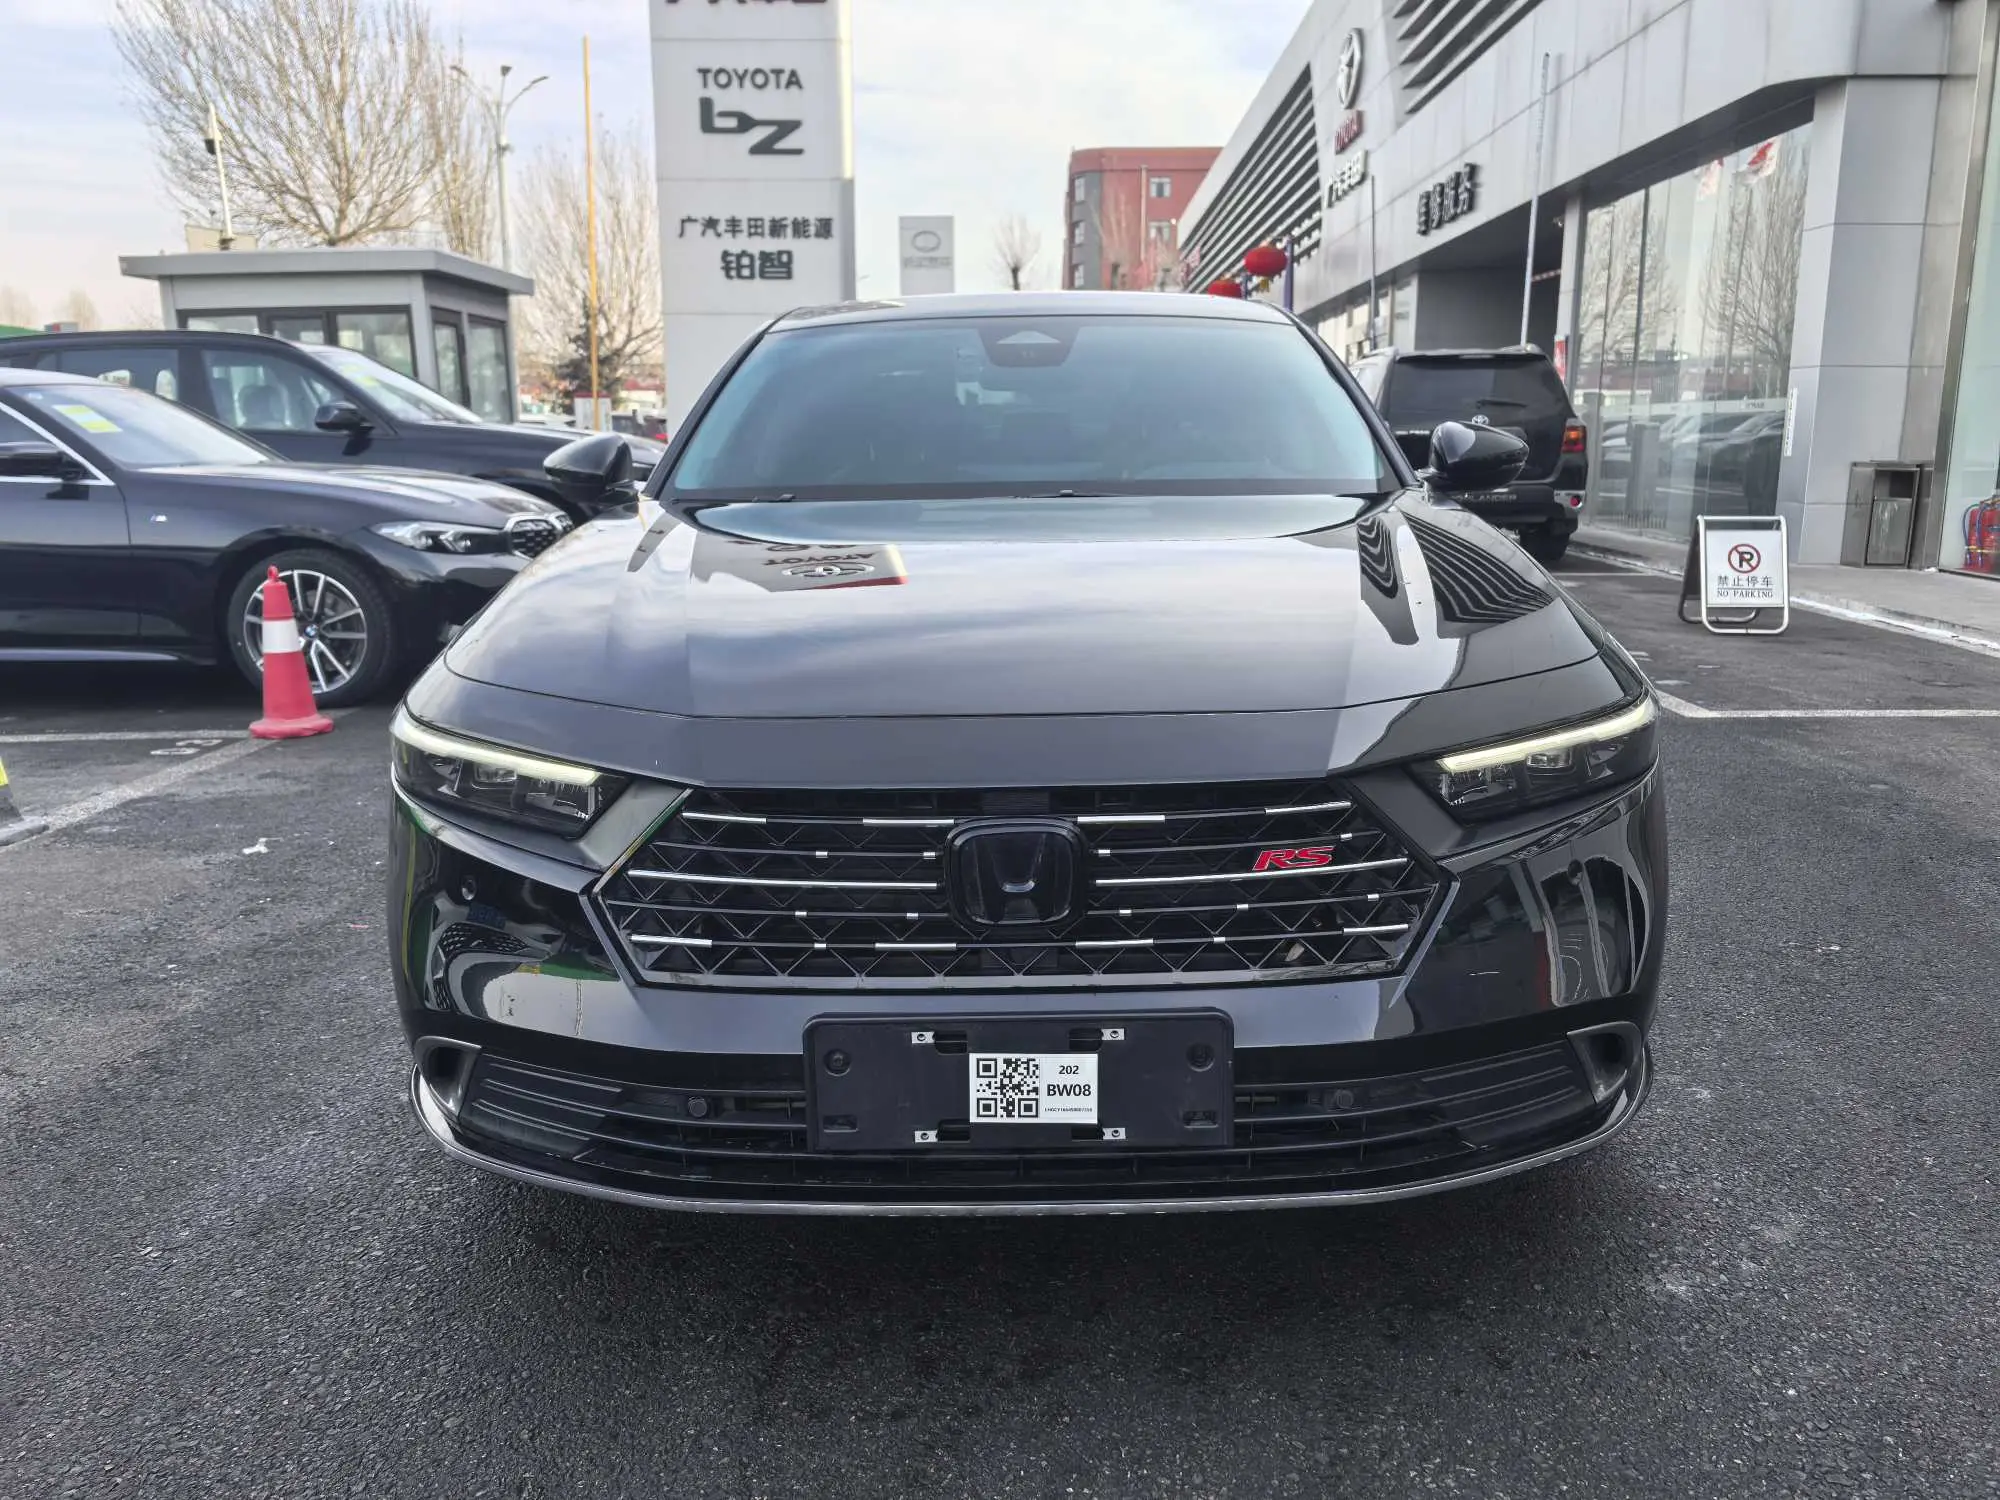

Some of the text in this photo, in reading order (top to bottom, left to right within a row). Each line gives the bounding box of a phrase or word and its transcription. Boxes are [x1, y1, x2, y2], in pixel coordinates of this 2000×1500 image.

[697, 67, 804, 90] TOYOTA
[678, 215, 834, 239] 广汽丰田新能源
[720, 249, 793, 280] 铂智
[1717, 575, 1773, 588] 禁止停车
[1717, 590, 1773, 599] NO PARKING
[1252, 844, 1336, 871] RS
[1058, 1065, 1079, 1075] 202
[1046, 1084, 1092, 1097] BW08
